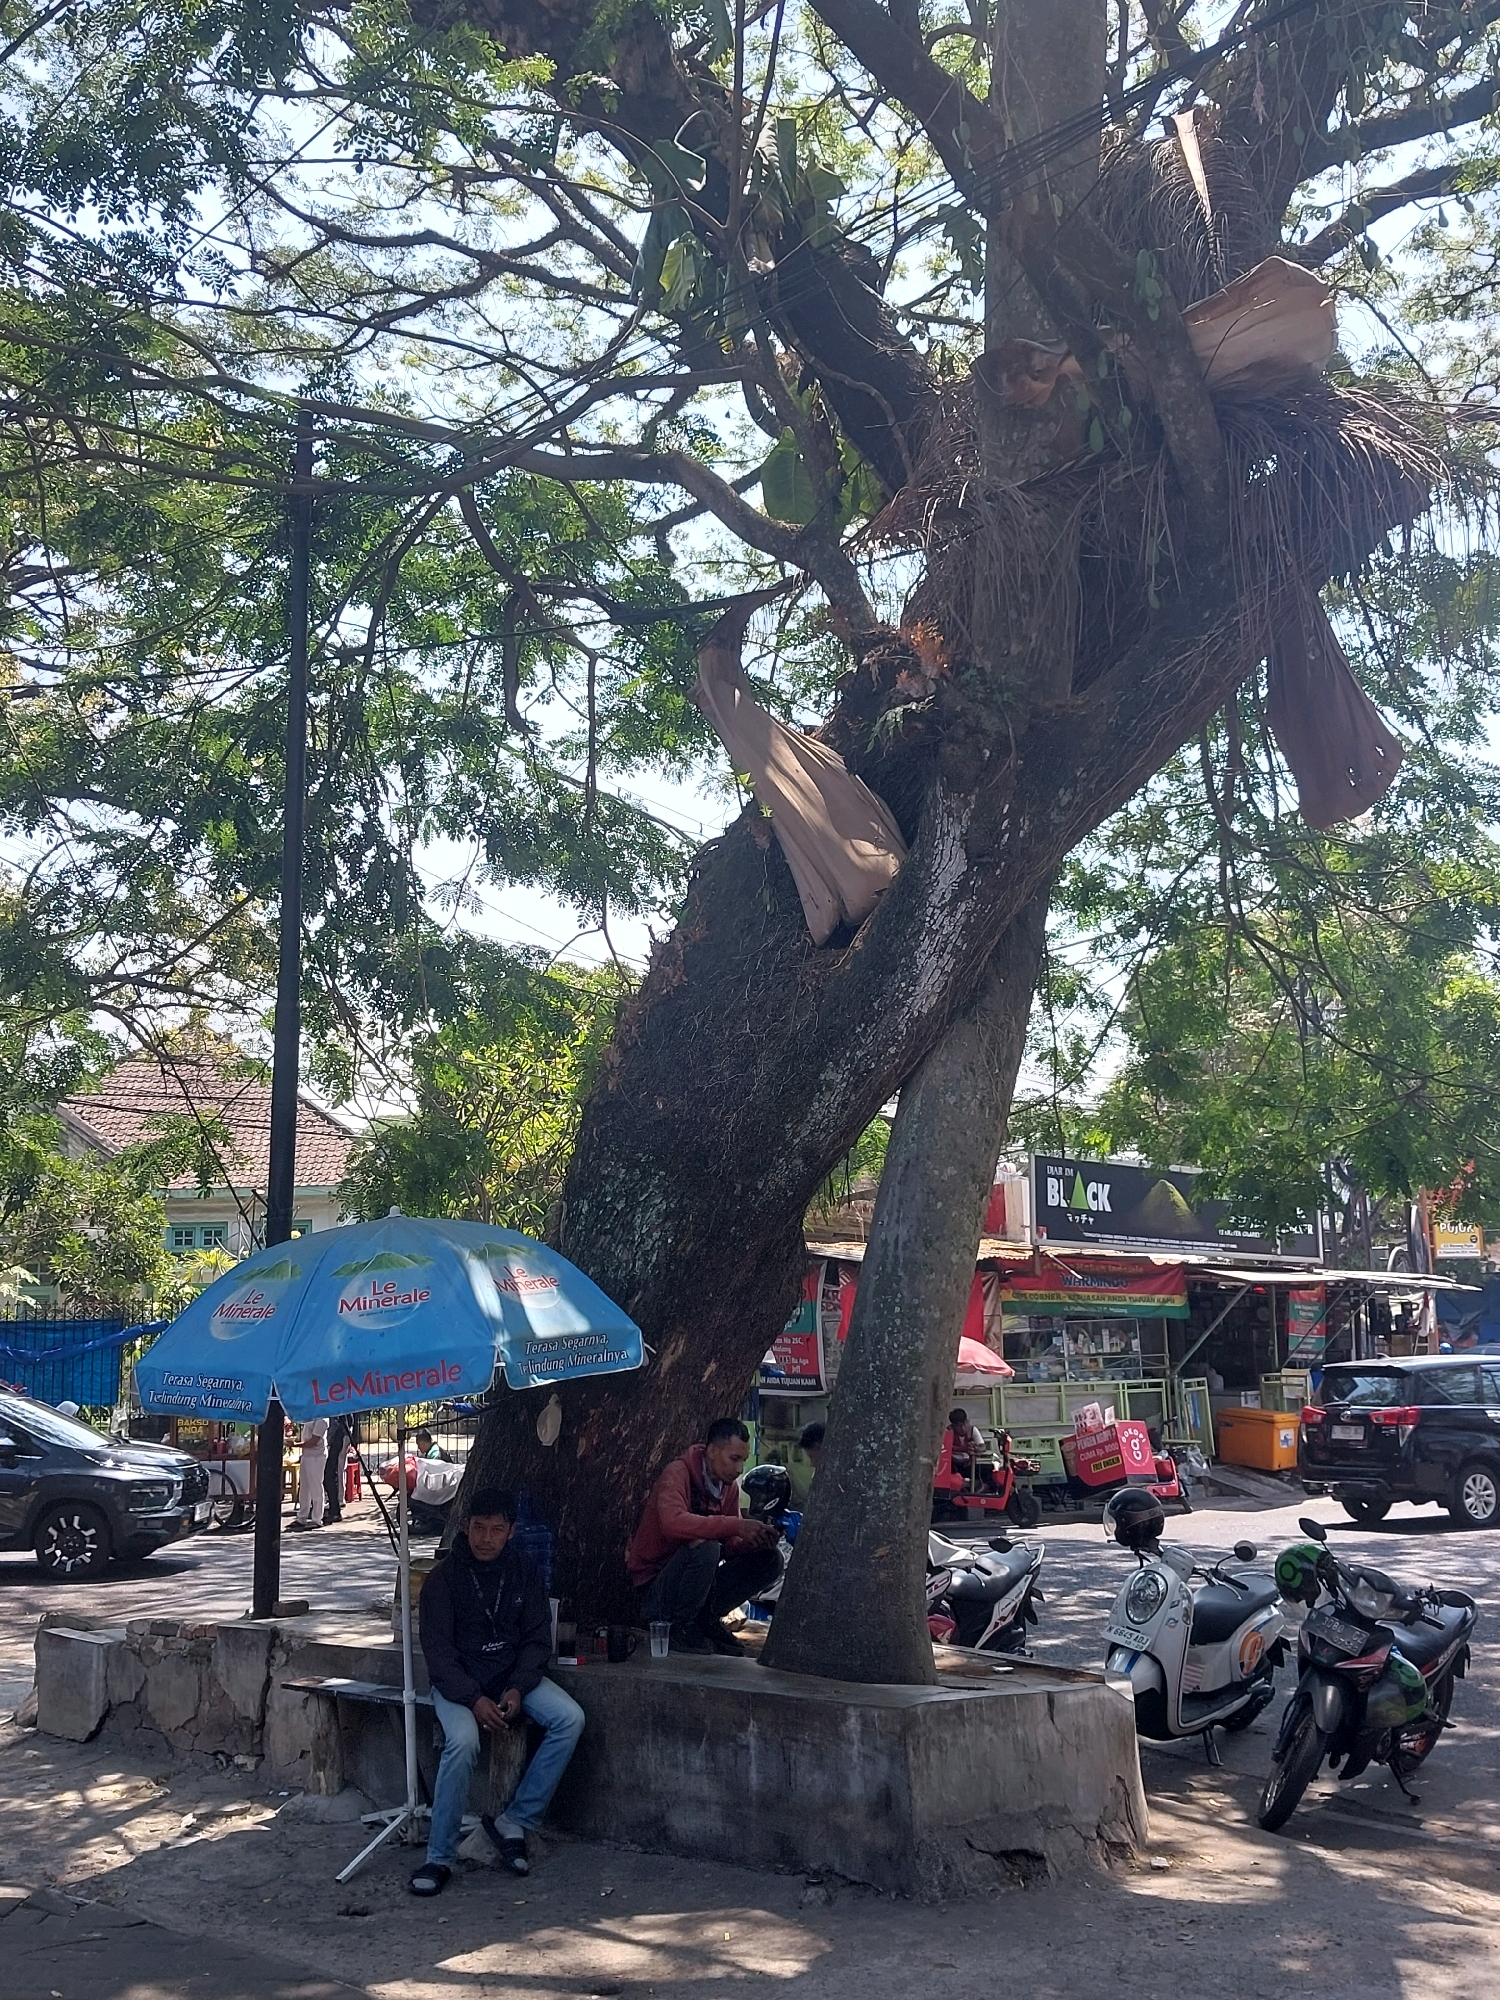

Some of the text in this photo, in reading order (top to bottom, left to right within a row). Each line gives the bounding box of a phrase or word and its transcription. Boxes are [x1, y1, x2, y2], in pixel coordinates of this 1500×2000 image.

[502, 1265, 528, 1279] Le
[372, 1280, 397, 1296] Le
[492, 1274, 560, 1293] Minerale
[243, 1288, 265, 1305] Le
[338, 1288, 430, 1314] Minerale
[212, 1302, 276, 1319] Minerale
[525, 1334, 609, 1355] Terasa Segarnya,
[567, 1349, 628, 1367] Mineralnya
[162, 1372, 245, 1393] Terasa Segarnya,
[200, 1393, 253, 1413] Mineralnya
[1106, 1625, 1115, 1633] N
[1321, 1616, 1345, 1633] 3080
